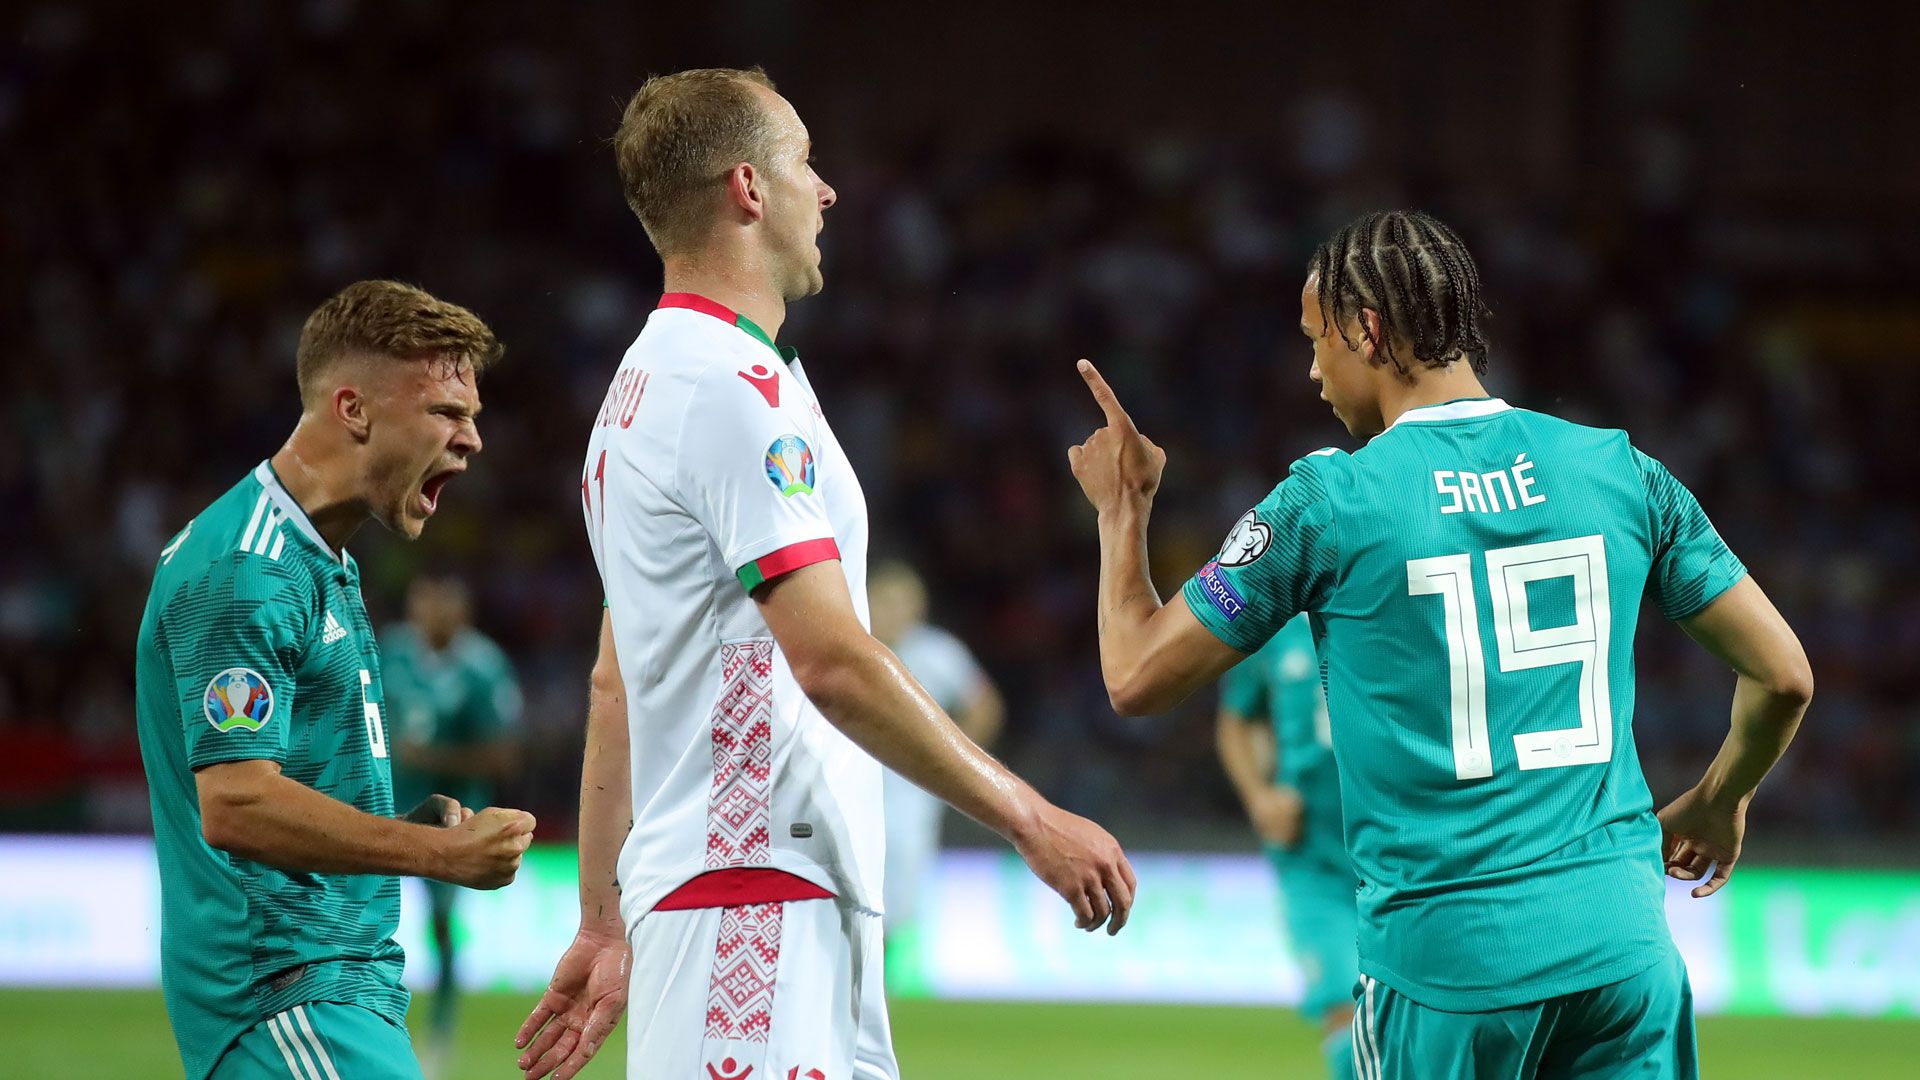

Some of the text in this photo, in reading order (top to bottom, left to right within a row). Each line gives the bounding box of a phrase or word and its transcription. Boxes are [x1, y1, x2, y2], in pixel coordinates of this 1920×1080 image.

[1433, 452, 1547, 514] SANÉ
[1205, 570, 1242, 615] RESPECT
[322, 626, 347, 644] adidas
[1406, 534, 1613, 780] 19
[359, 669, 388, 758] 6
